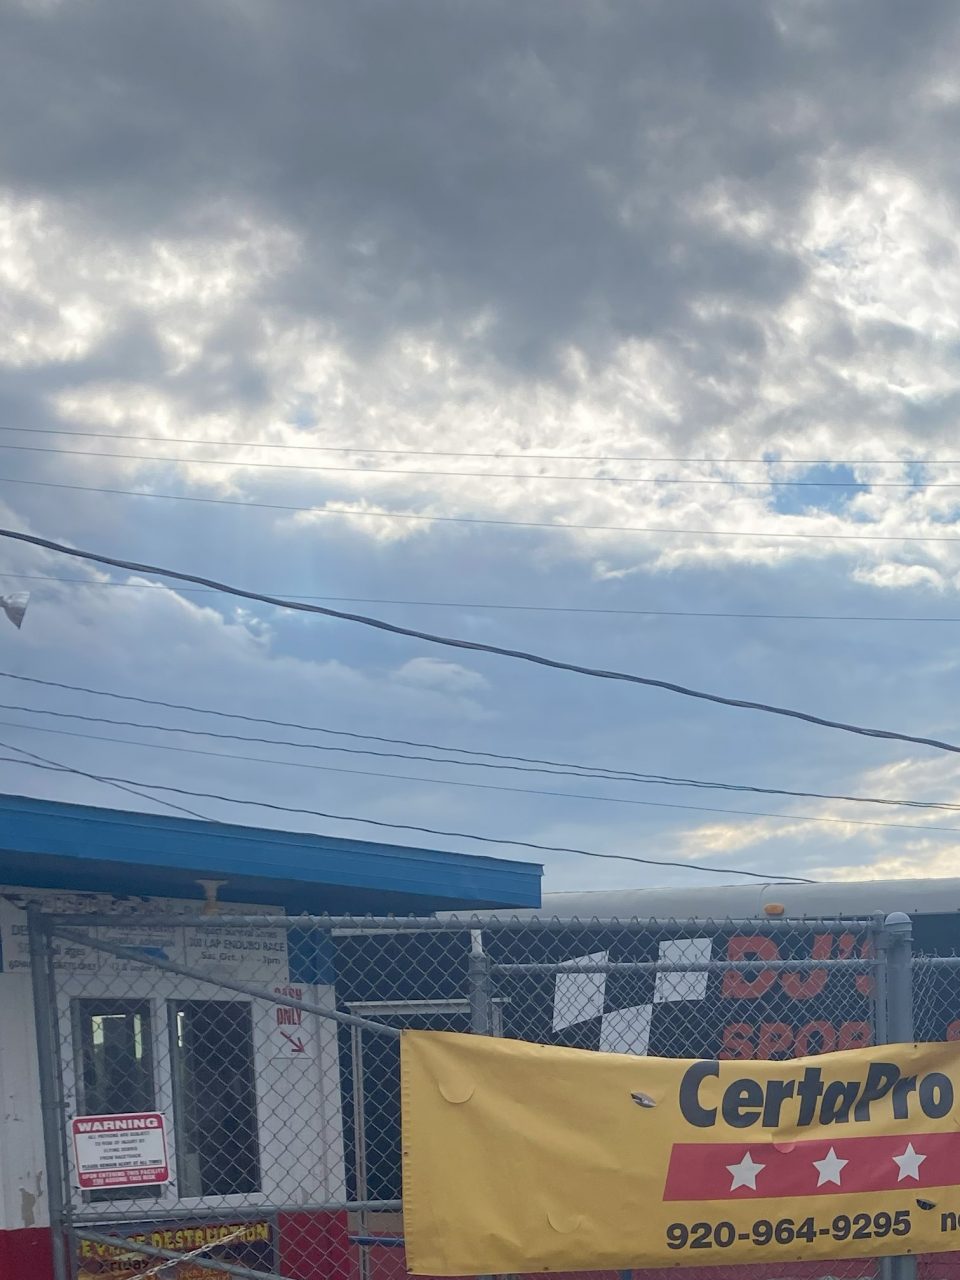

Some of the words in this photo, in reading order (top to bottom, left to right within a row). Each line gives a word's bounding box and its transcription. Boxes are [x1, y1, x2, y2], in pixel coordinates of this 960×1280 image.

[276, 1007, 302, 1026] ONLY
[720, 1021, 873, 1059] SPOR
[678, 1060, 955, 1128] CertaPro
[77, 1118, 158, 1132] WARNING
[152, 1222, 269, 1249] DESTRUCTION
[666, 1210, 911, 1251] 920-964-9295
